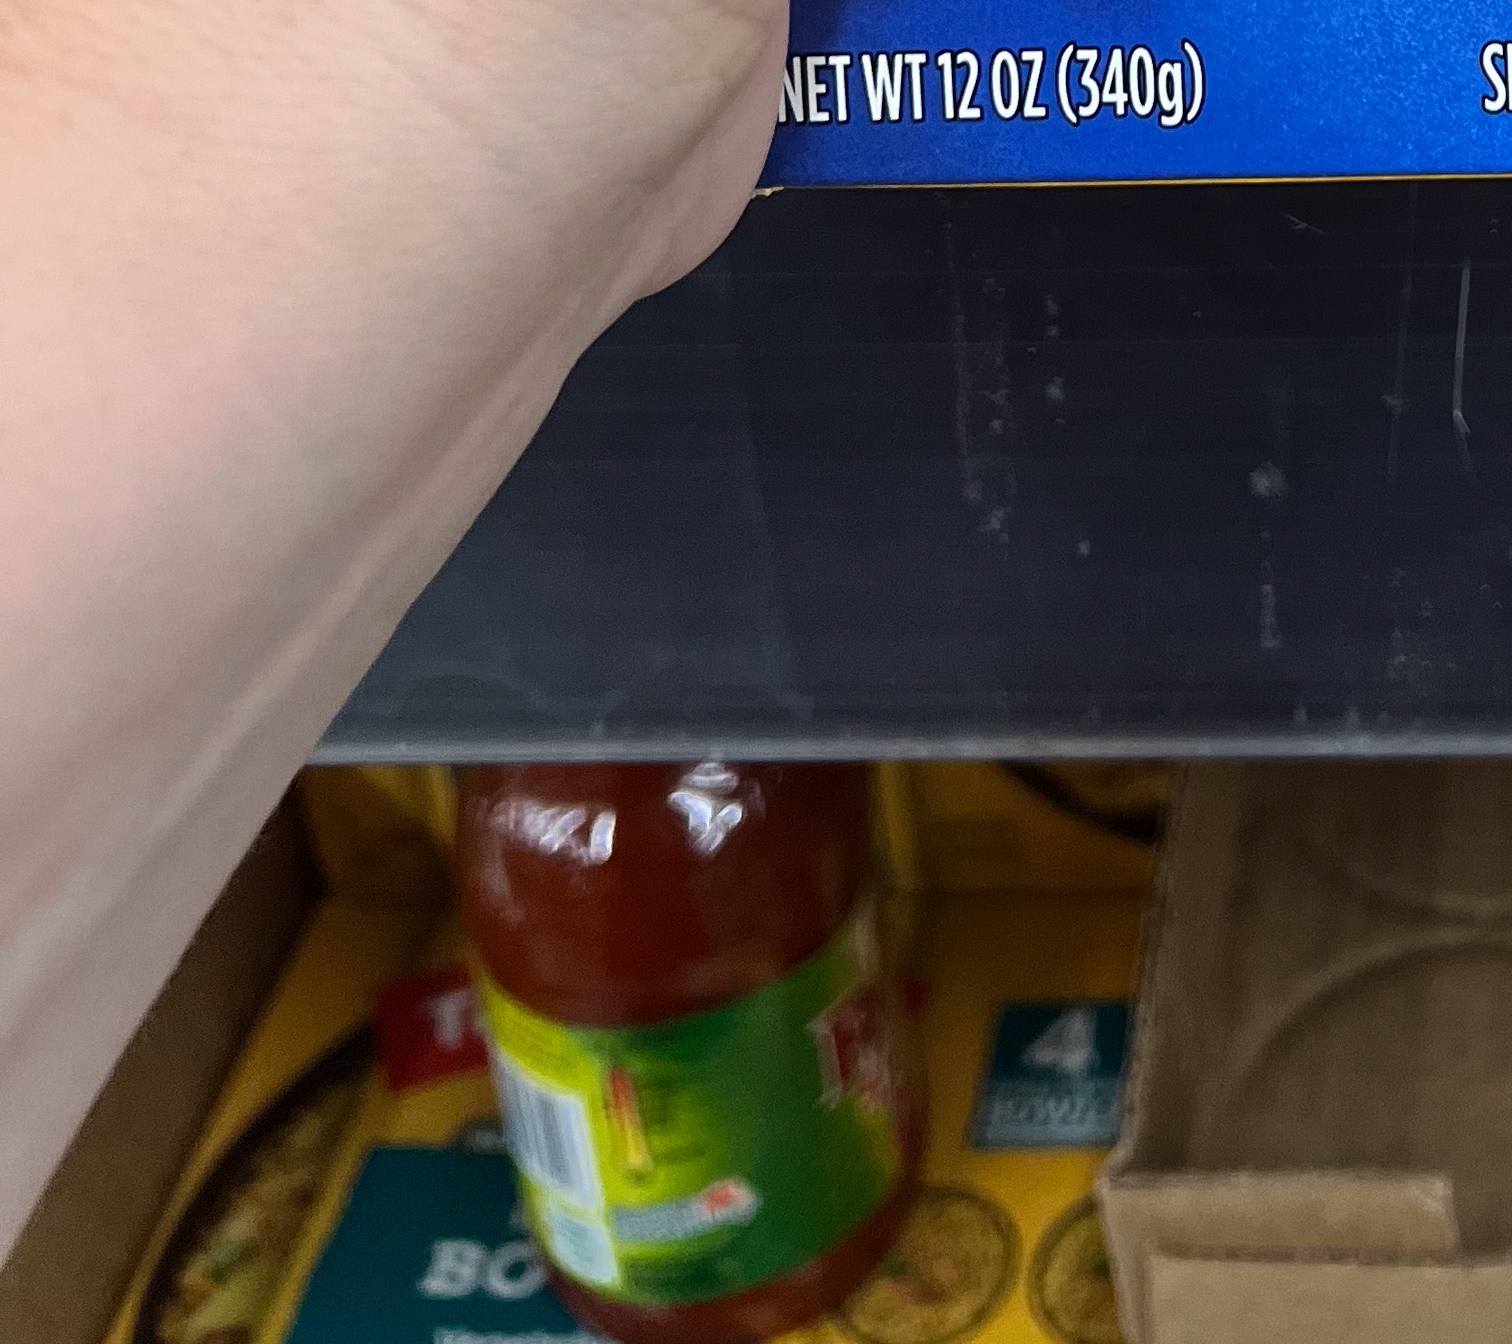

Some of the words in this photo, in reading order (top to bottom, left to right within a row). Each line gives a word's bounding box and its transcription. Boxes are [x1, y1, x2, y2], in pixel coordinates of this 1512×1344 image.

[778, 54, 851, 123] NET
[860, 52, 928, 121] WT
[937, 50, 981, 120] 12
[990, 49, 1047, 120] OZ
[1057, 41, 1202, 128] (340g)
